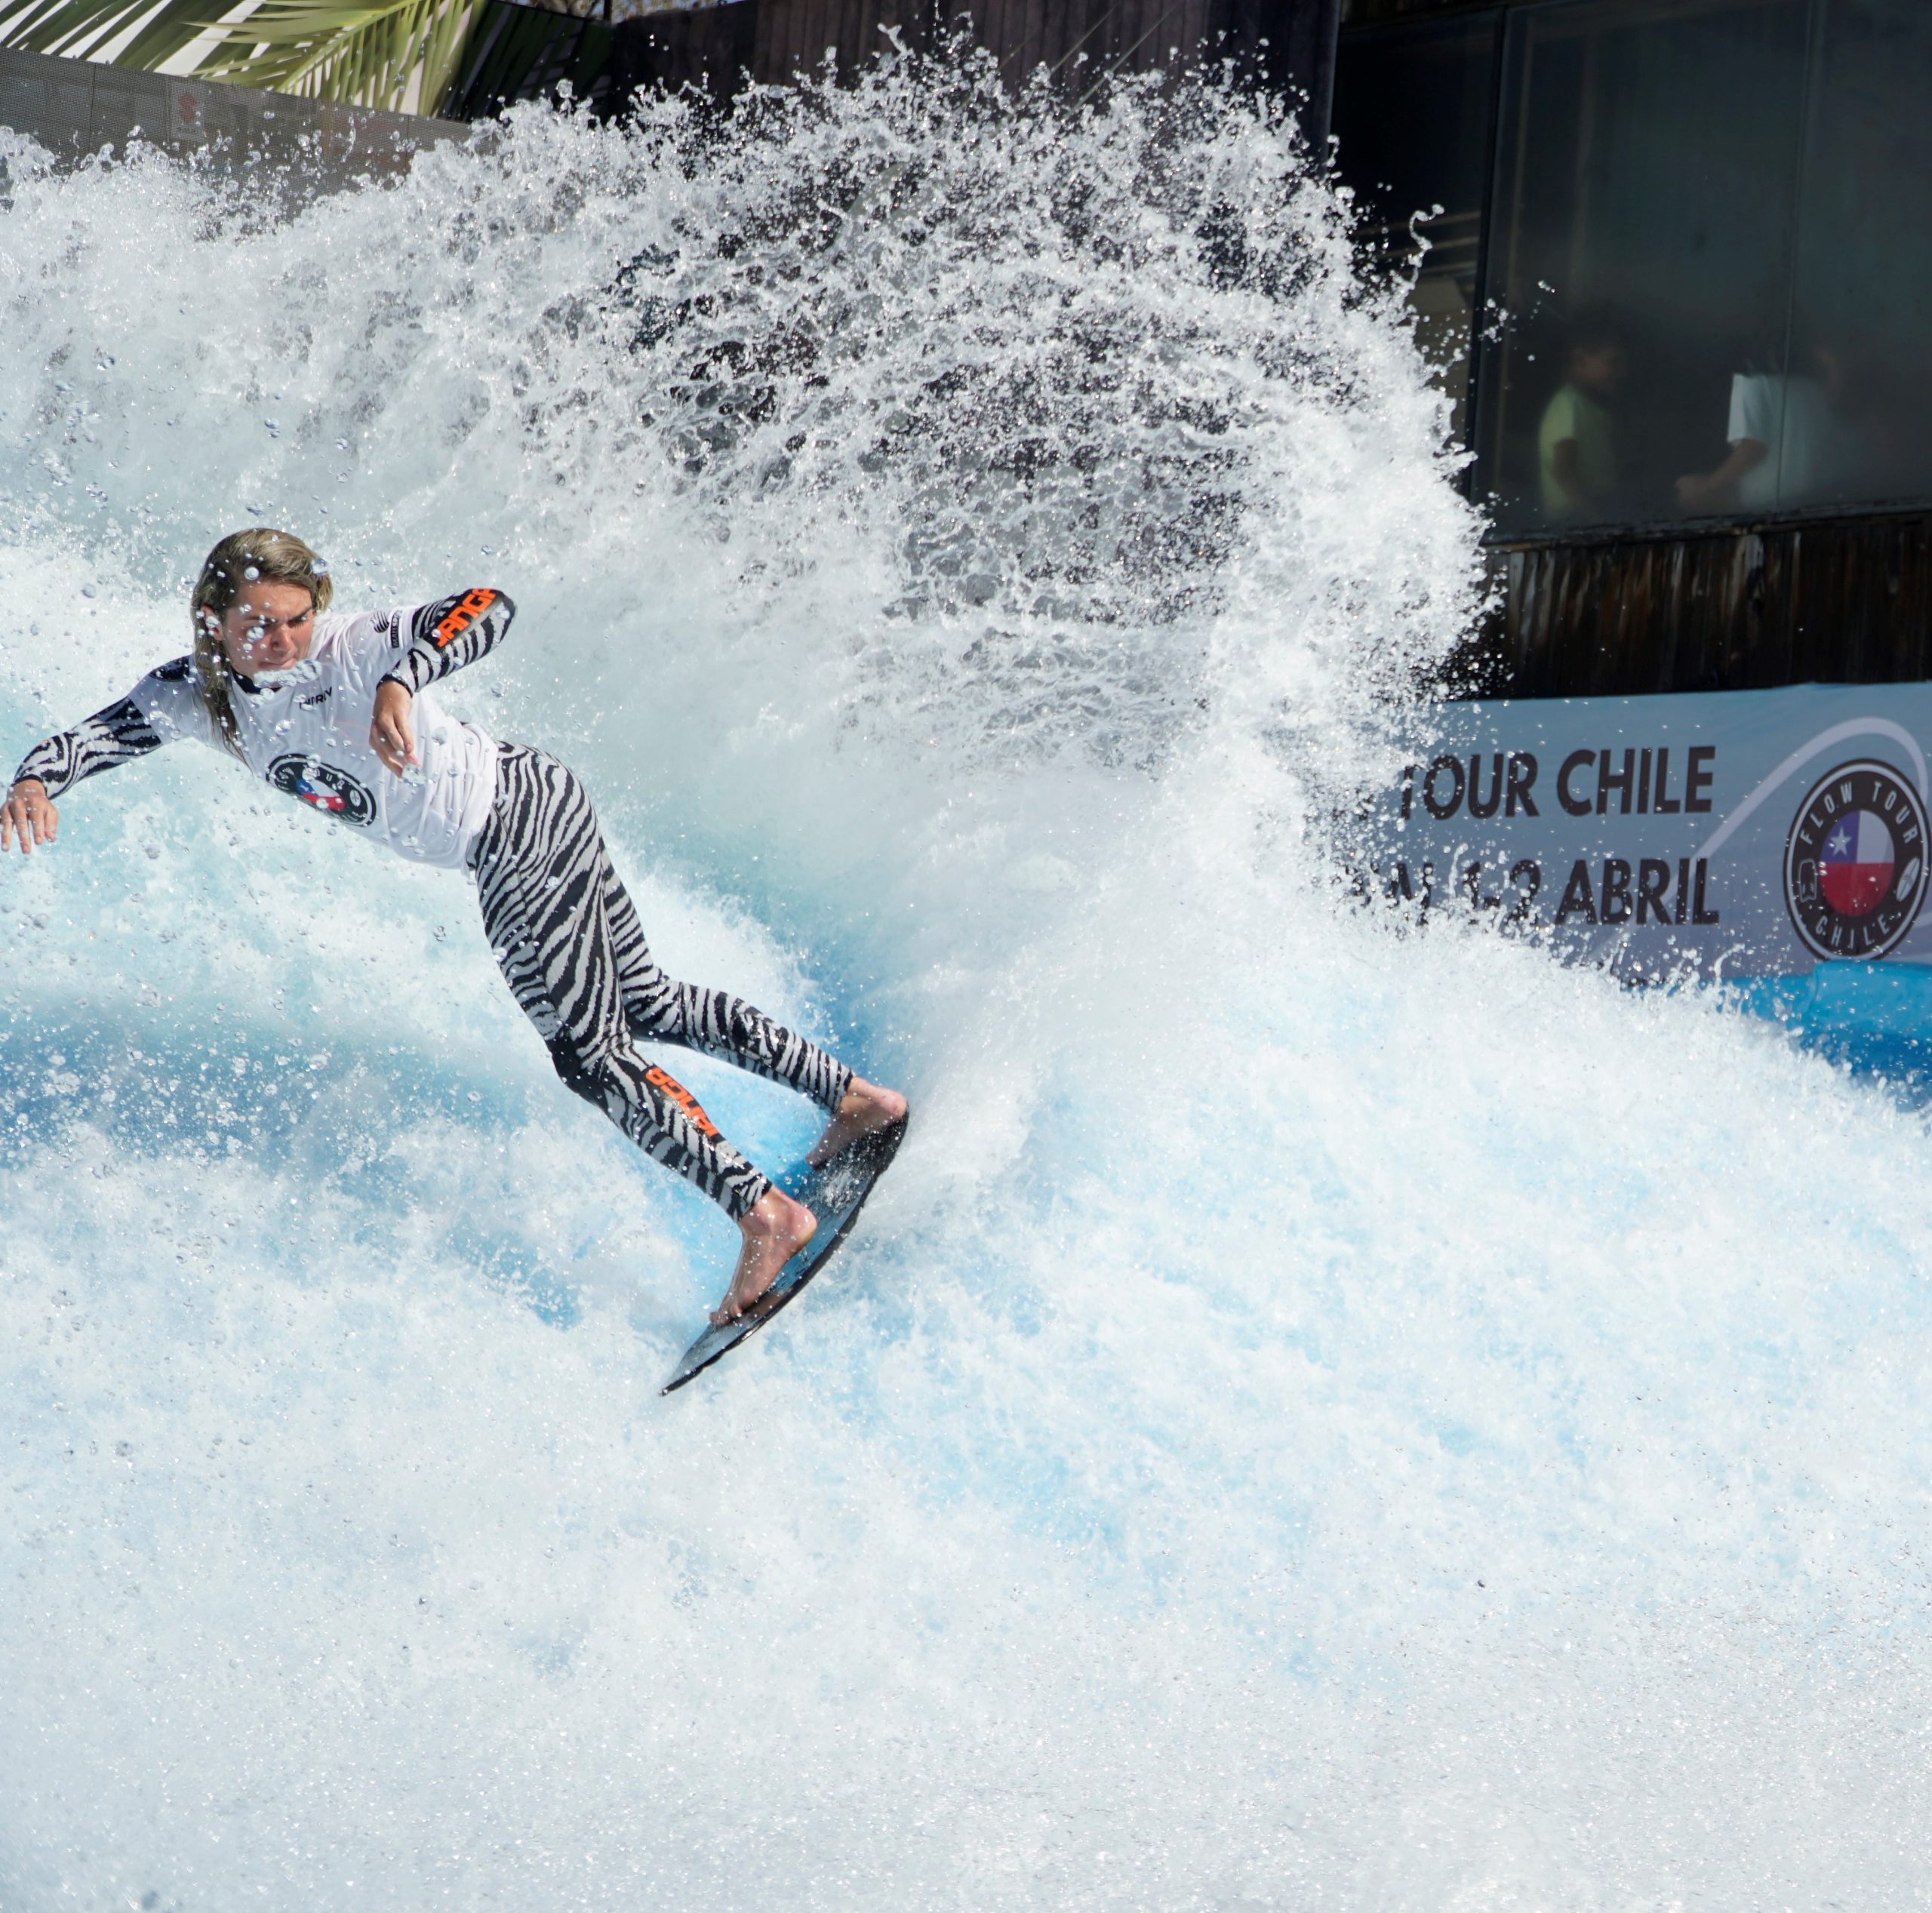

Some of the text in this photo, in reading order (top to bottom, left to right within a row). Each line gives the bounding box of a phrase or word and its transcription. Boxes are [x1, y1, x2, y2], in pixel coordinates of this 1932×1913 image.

[1401, 746, 1716, 820] TOUR CHILE
[1800, 780, 1918, 844] FLOW TOUR
[1555, 857, 1720, 926] ABRIL
[1815, 914, 1890, 949] CHILE
